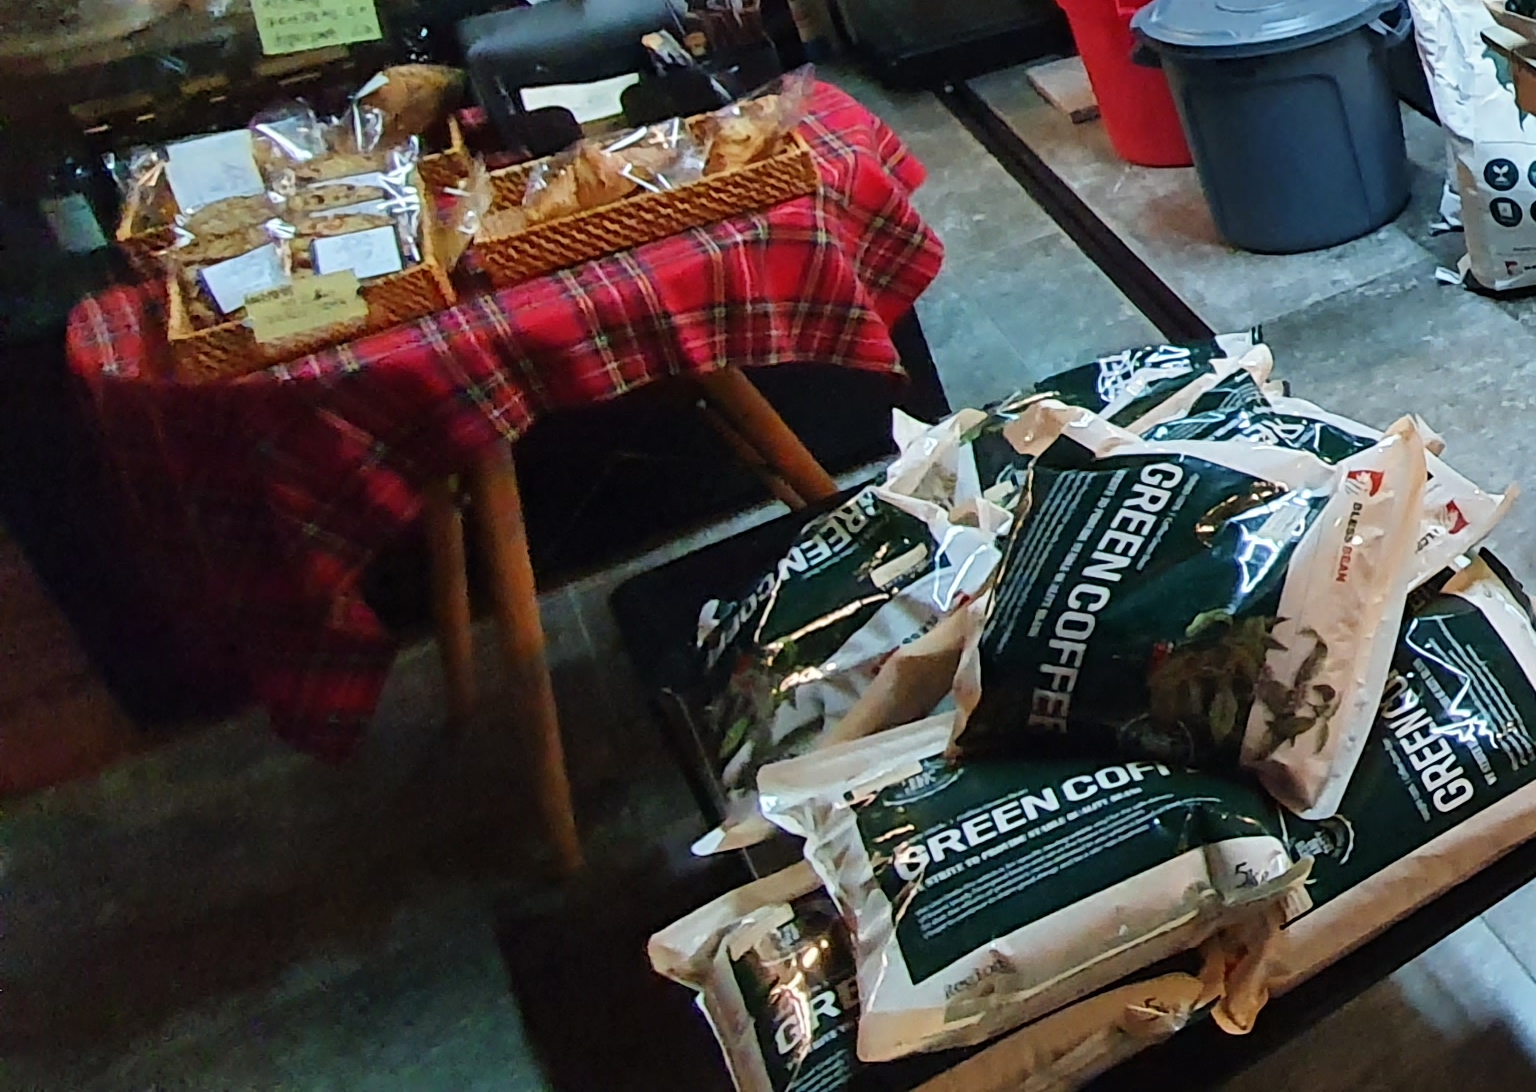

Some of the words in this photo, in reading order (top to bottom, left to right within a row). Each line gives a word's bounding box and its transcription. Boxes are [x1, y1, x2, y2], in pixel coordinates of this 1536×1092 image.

[1081, 461, 1183, 582] GREEN
[1028, 581, 1112, 734] COFFEE
[894, 786, 1056, 882] GREEN
